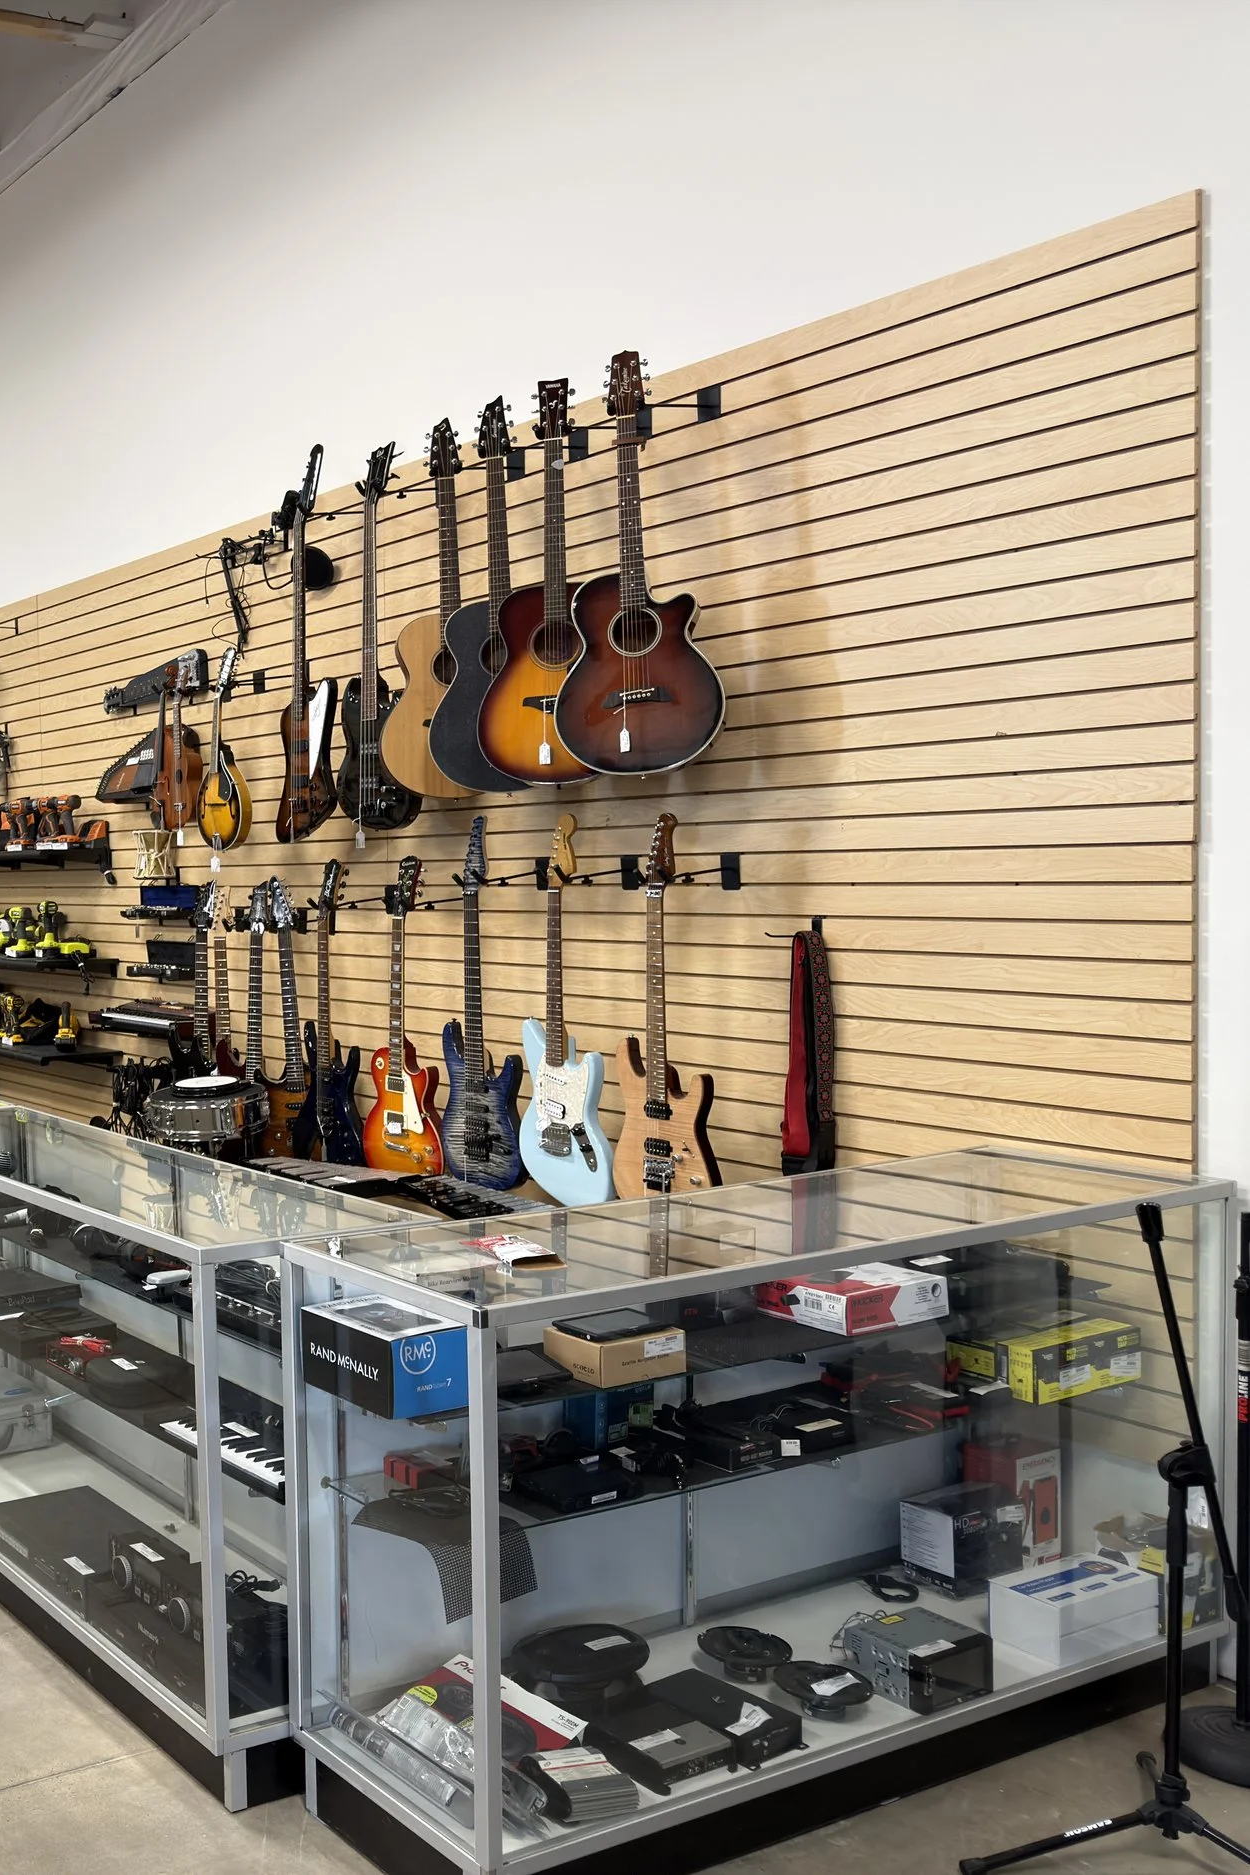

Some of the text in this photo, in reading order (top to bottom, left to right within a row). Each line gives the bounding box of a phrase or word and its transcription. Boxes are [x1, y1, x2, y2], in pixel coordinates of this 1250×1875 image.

[856, 1294, 883, 1305] KICKER
[310, 1342, 337, 1364] RAND
[1237, 1374, 1249, 1424] PROLINE
[954, 1518, 970, 1530] HD
[1064, 1819, 1113, 1838] SAMSON
